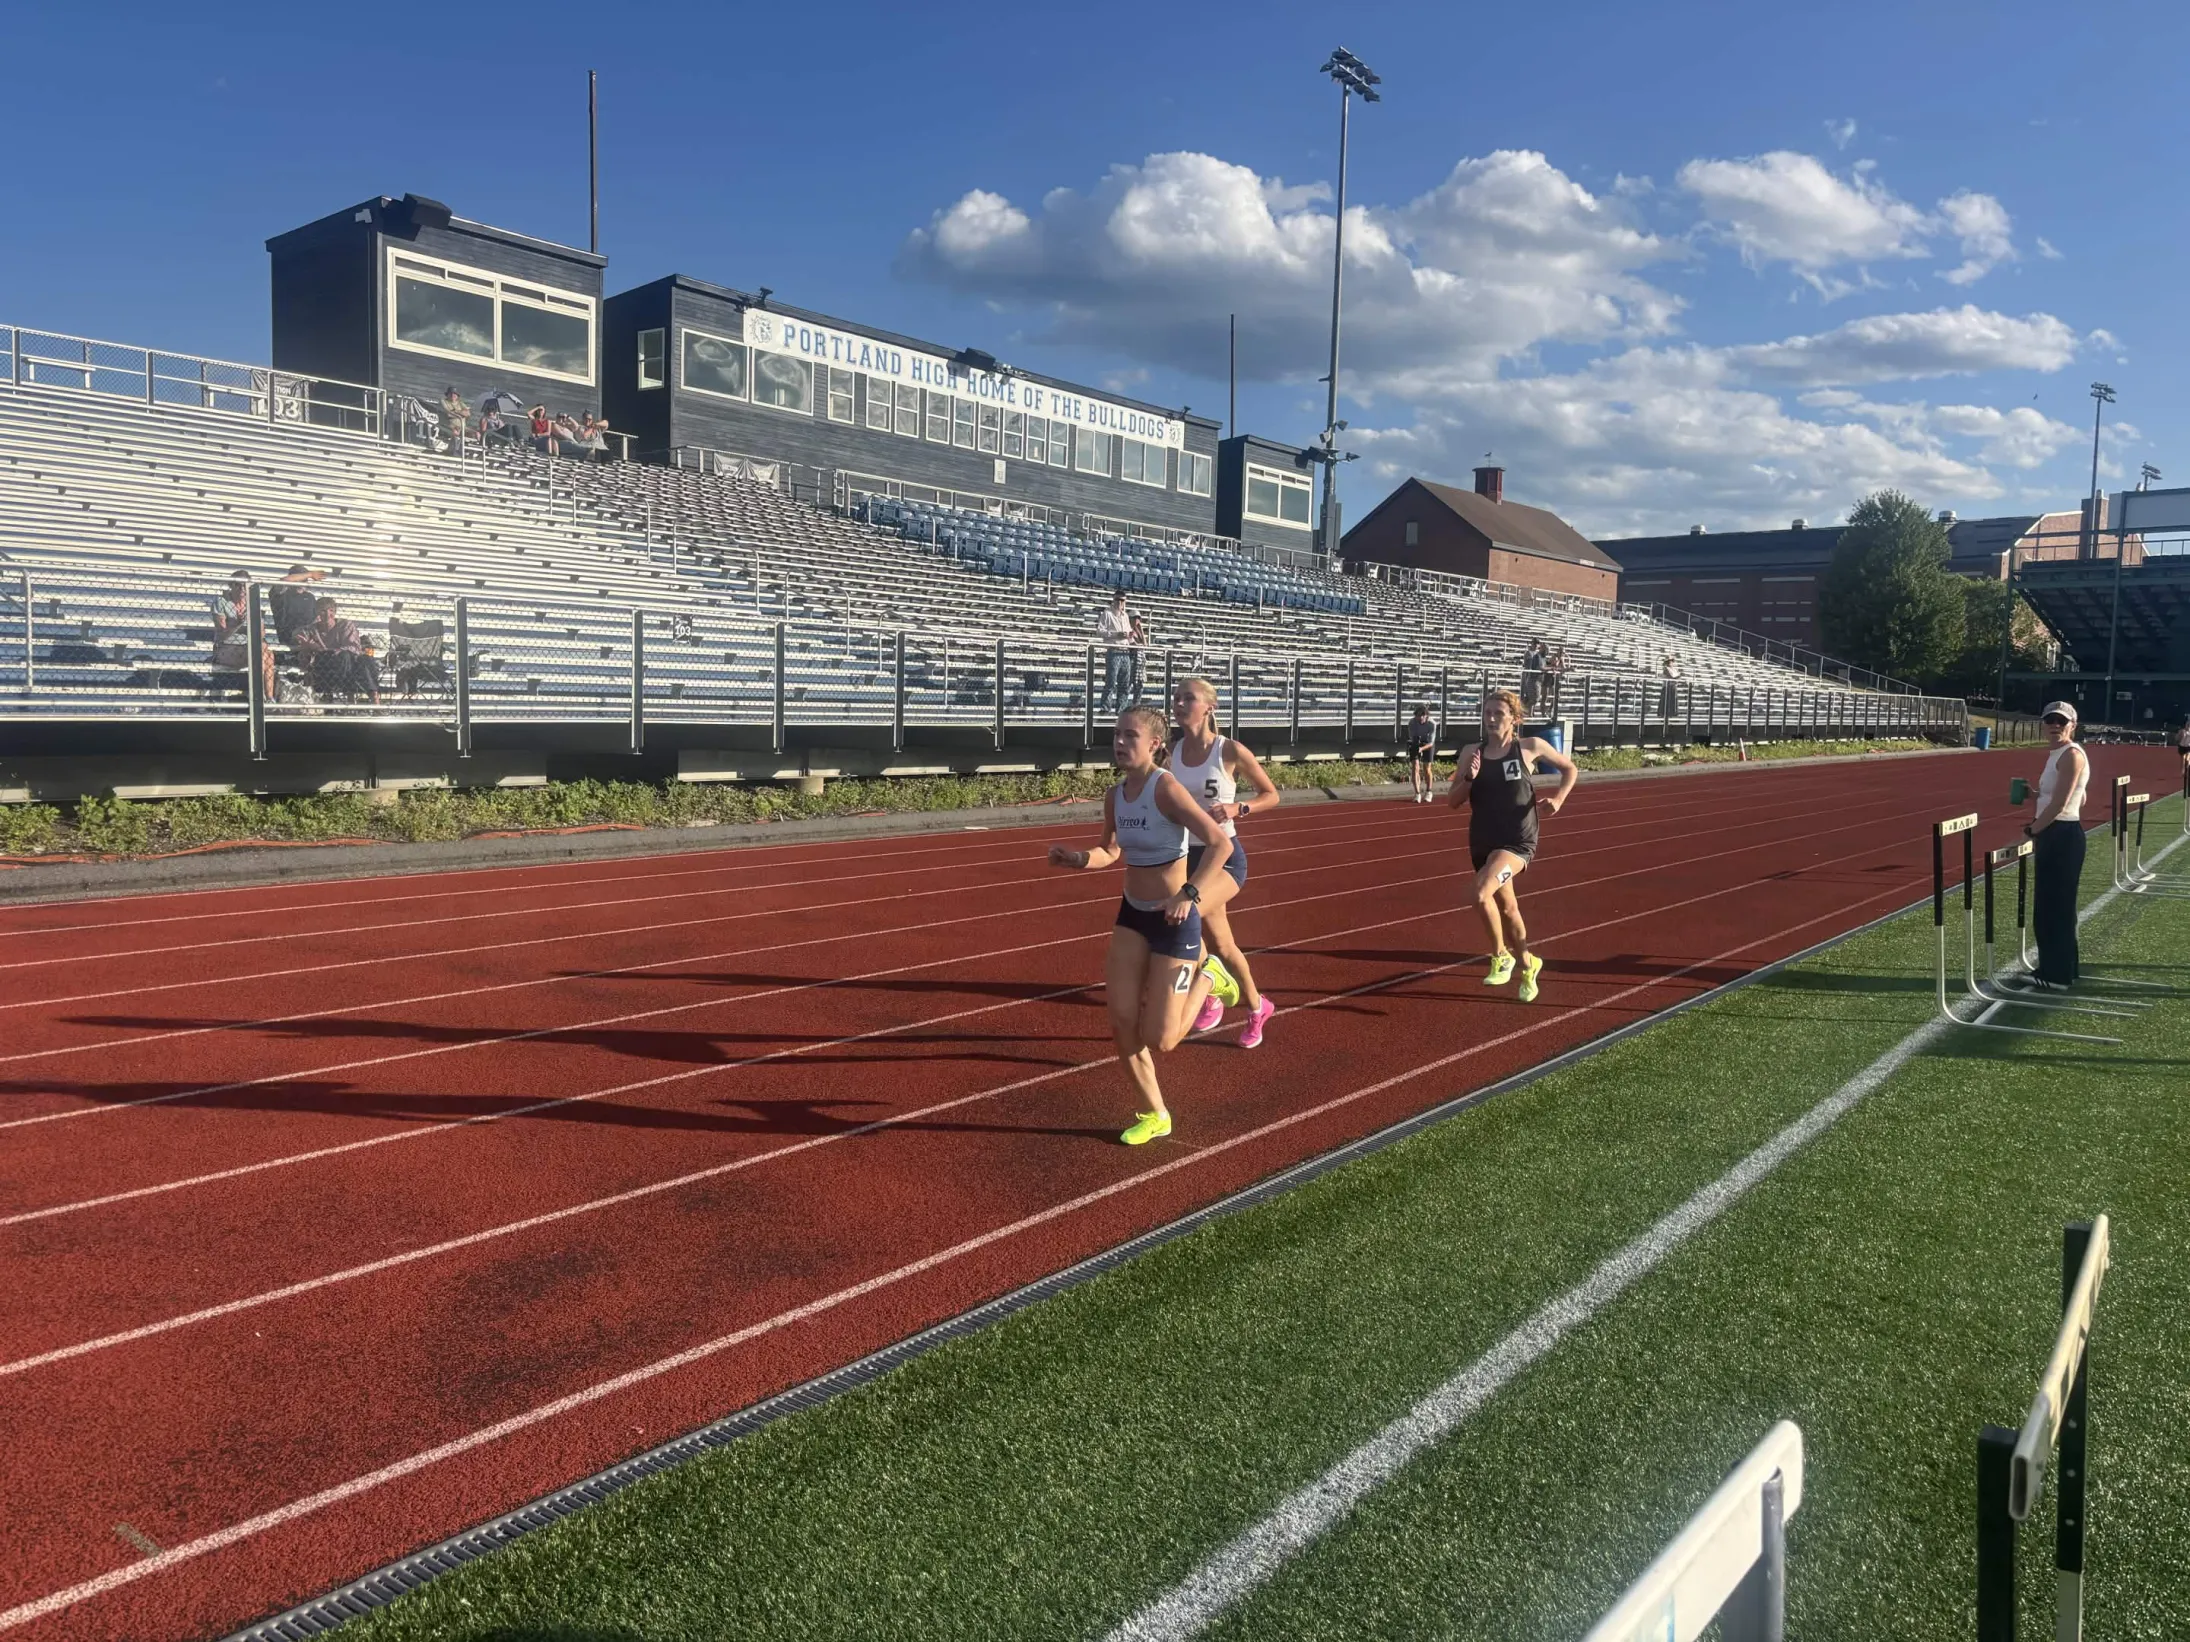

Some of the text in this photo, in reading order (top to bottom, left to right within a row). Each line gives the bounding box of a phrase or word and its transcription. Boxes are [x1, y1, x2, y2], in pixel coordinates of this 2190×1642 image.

[783, 323, 1164, 439] PORTLAND HIGH HOME OF THE BULLDOGS
[674, 624, 691, 636] 103
[1506, 762, 1520, 777] 4
[1204, 779, 1218, 798] 5
[1177, 966, 1190, 990] 2
